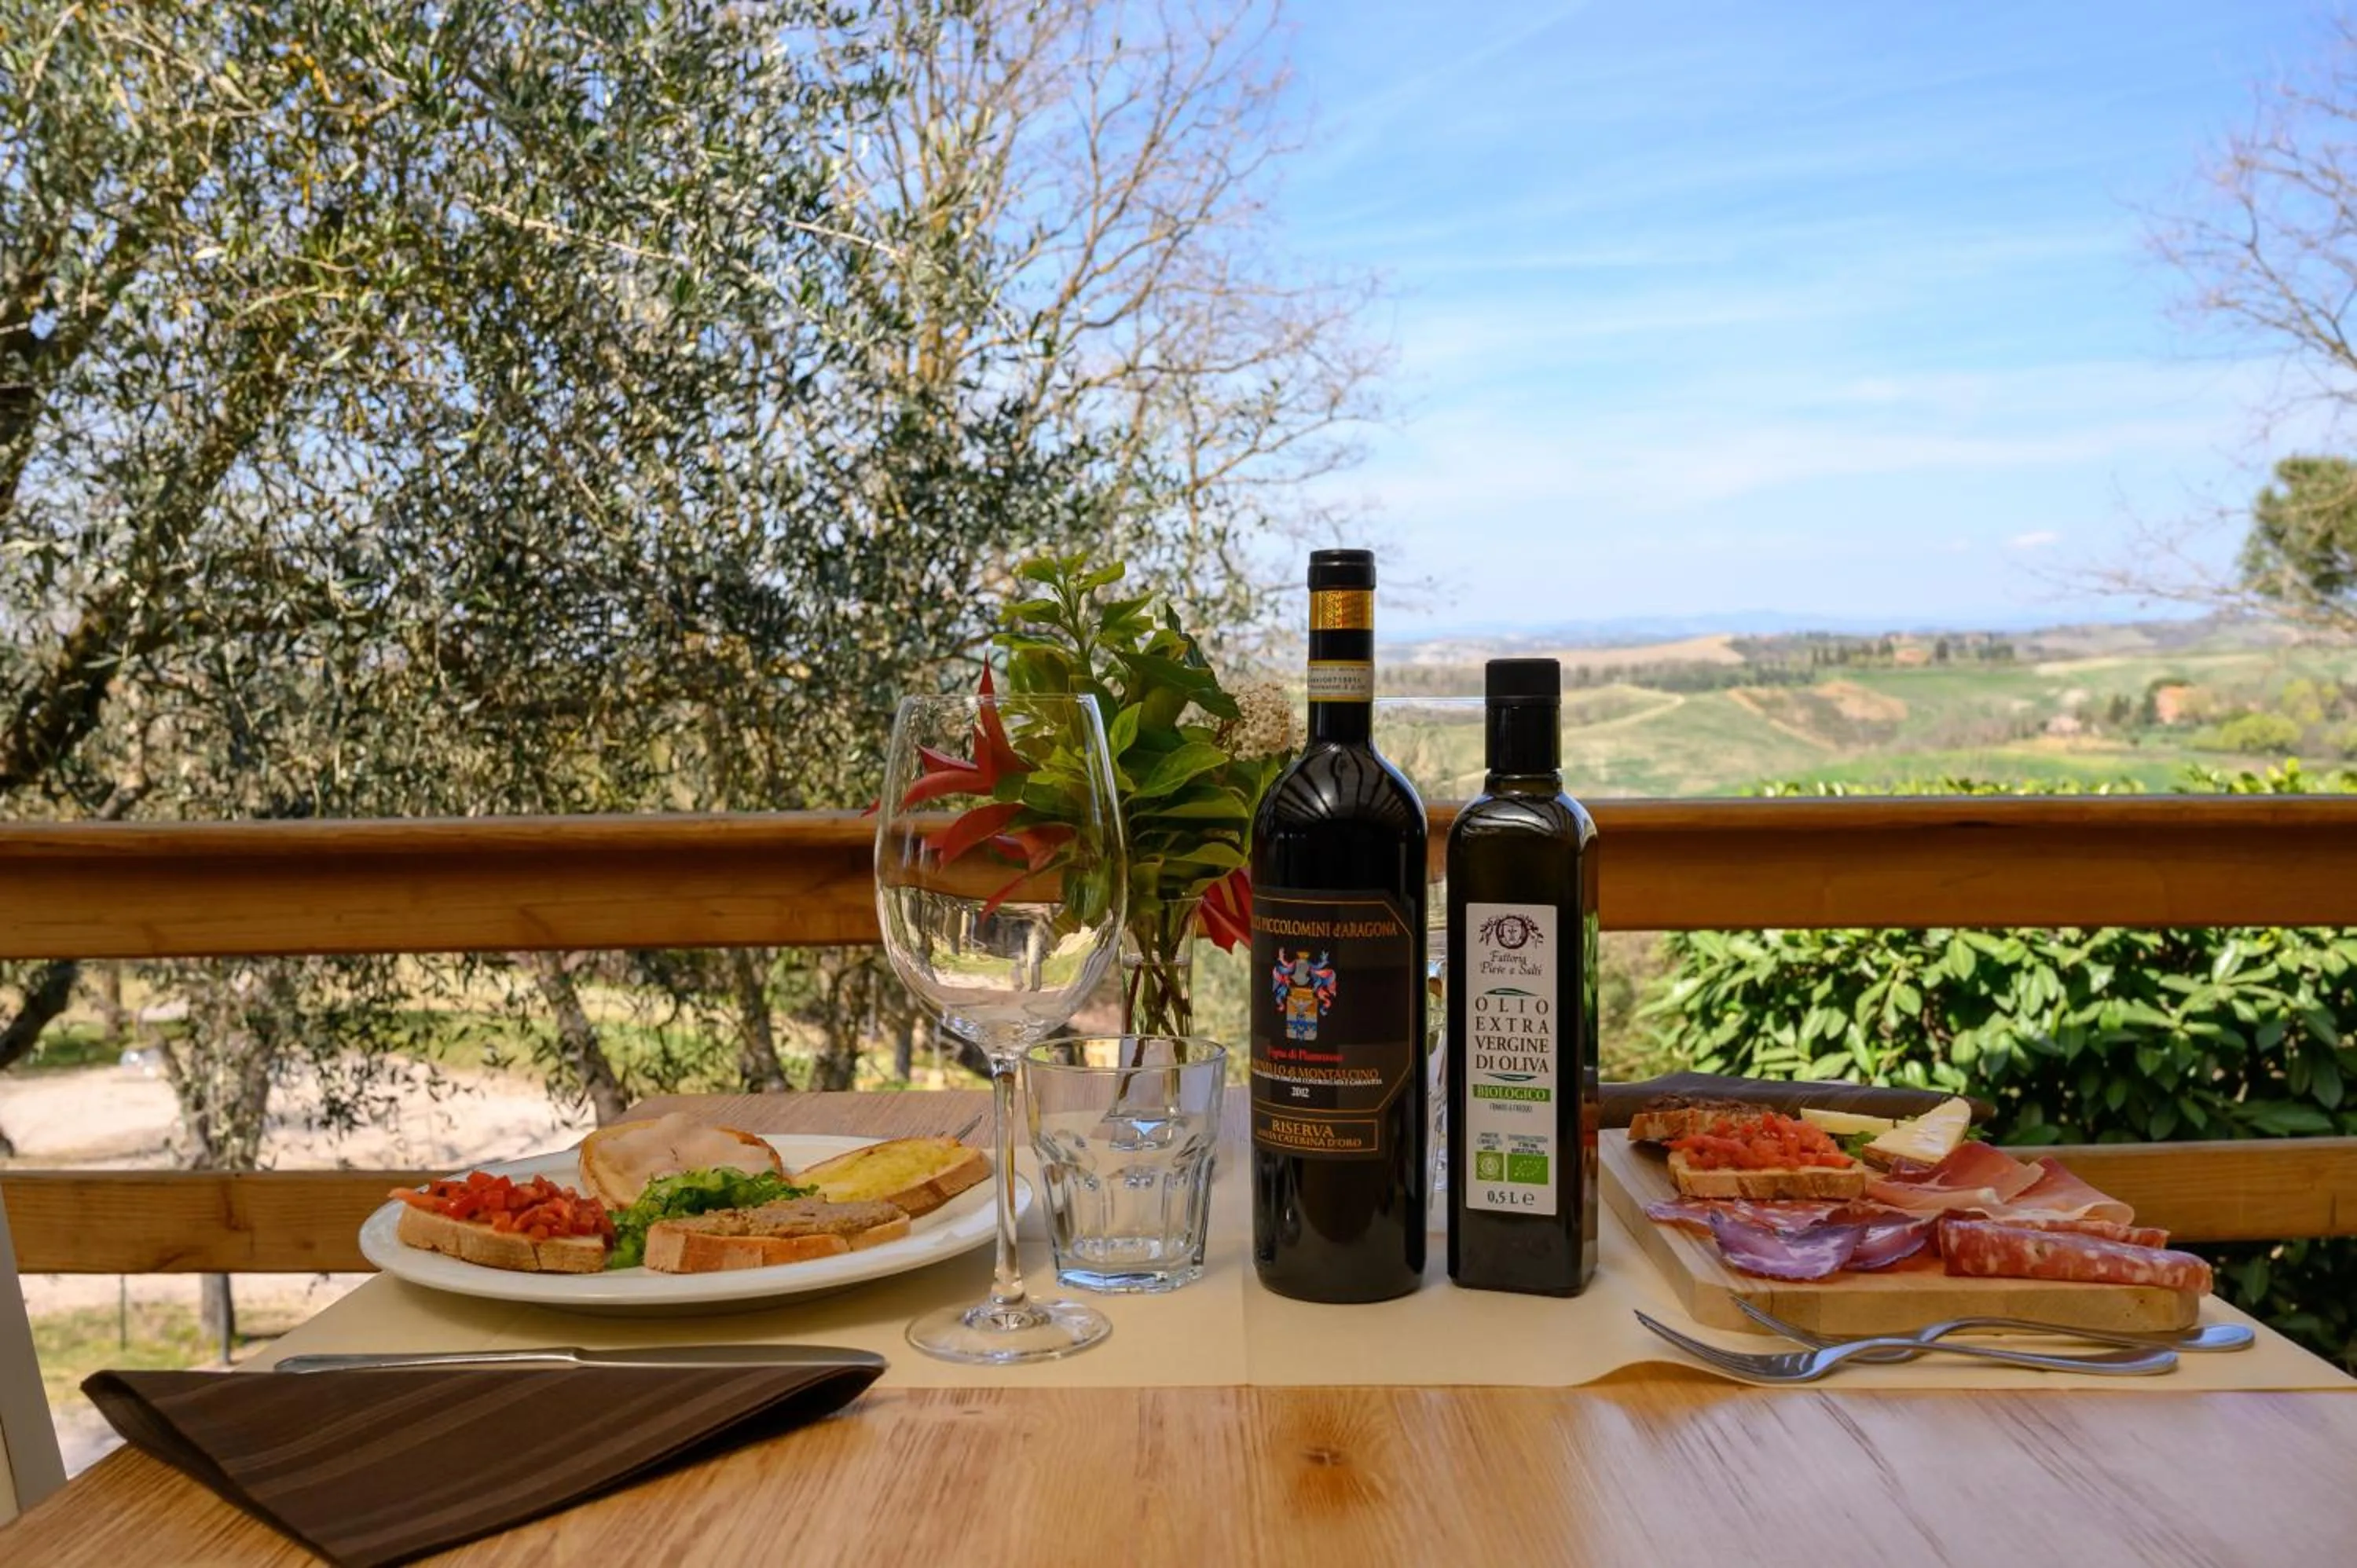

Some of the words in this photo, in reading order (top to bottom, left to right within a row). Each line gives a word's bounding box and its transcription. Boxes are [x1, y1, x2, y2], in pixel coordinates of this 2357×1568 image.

[1475, 996, 1549, 1015] OLIO
[1475, 1017, 1549, 1035] EXTRA
[1475, 1035, 1550, 1053] VERGINE
[1475, 1054, 1494, 1070] DI
[1499, 1055, 1549, 1073] OLIVA
[1477, 1086, 1546, 1101] BIOLOGICO
[1272, 1119, 1334, 1138] RISERVA
[1487, 1190, 1505, 1204] 0,5
